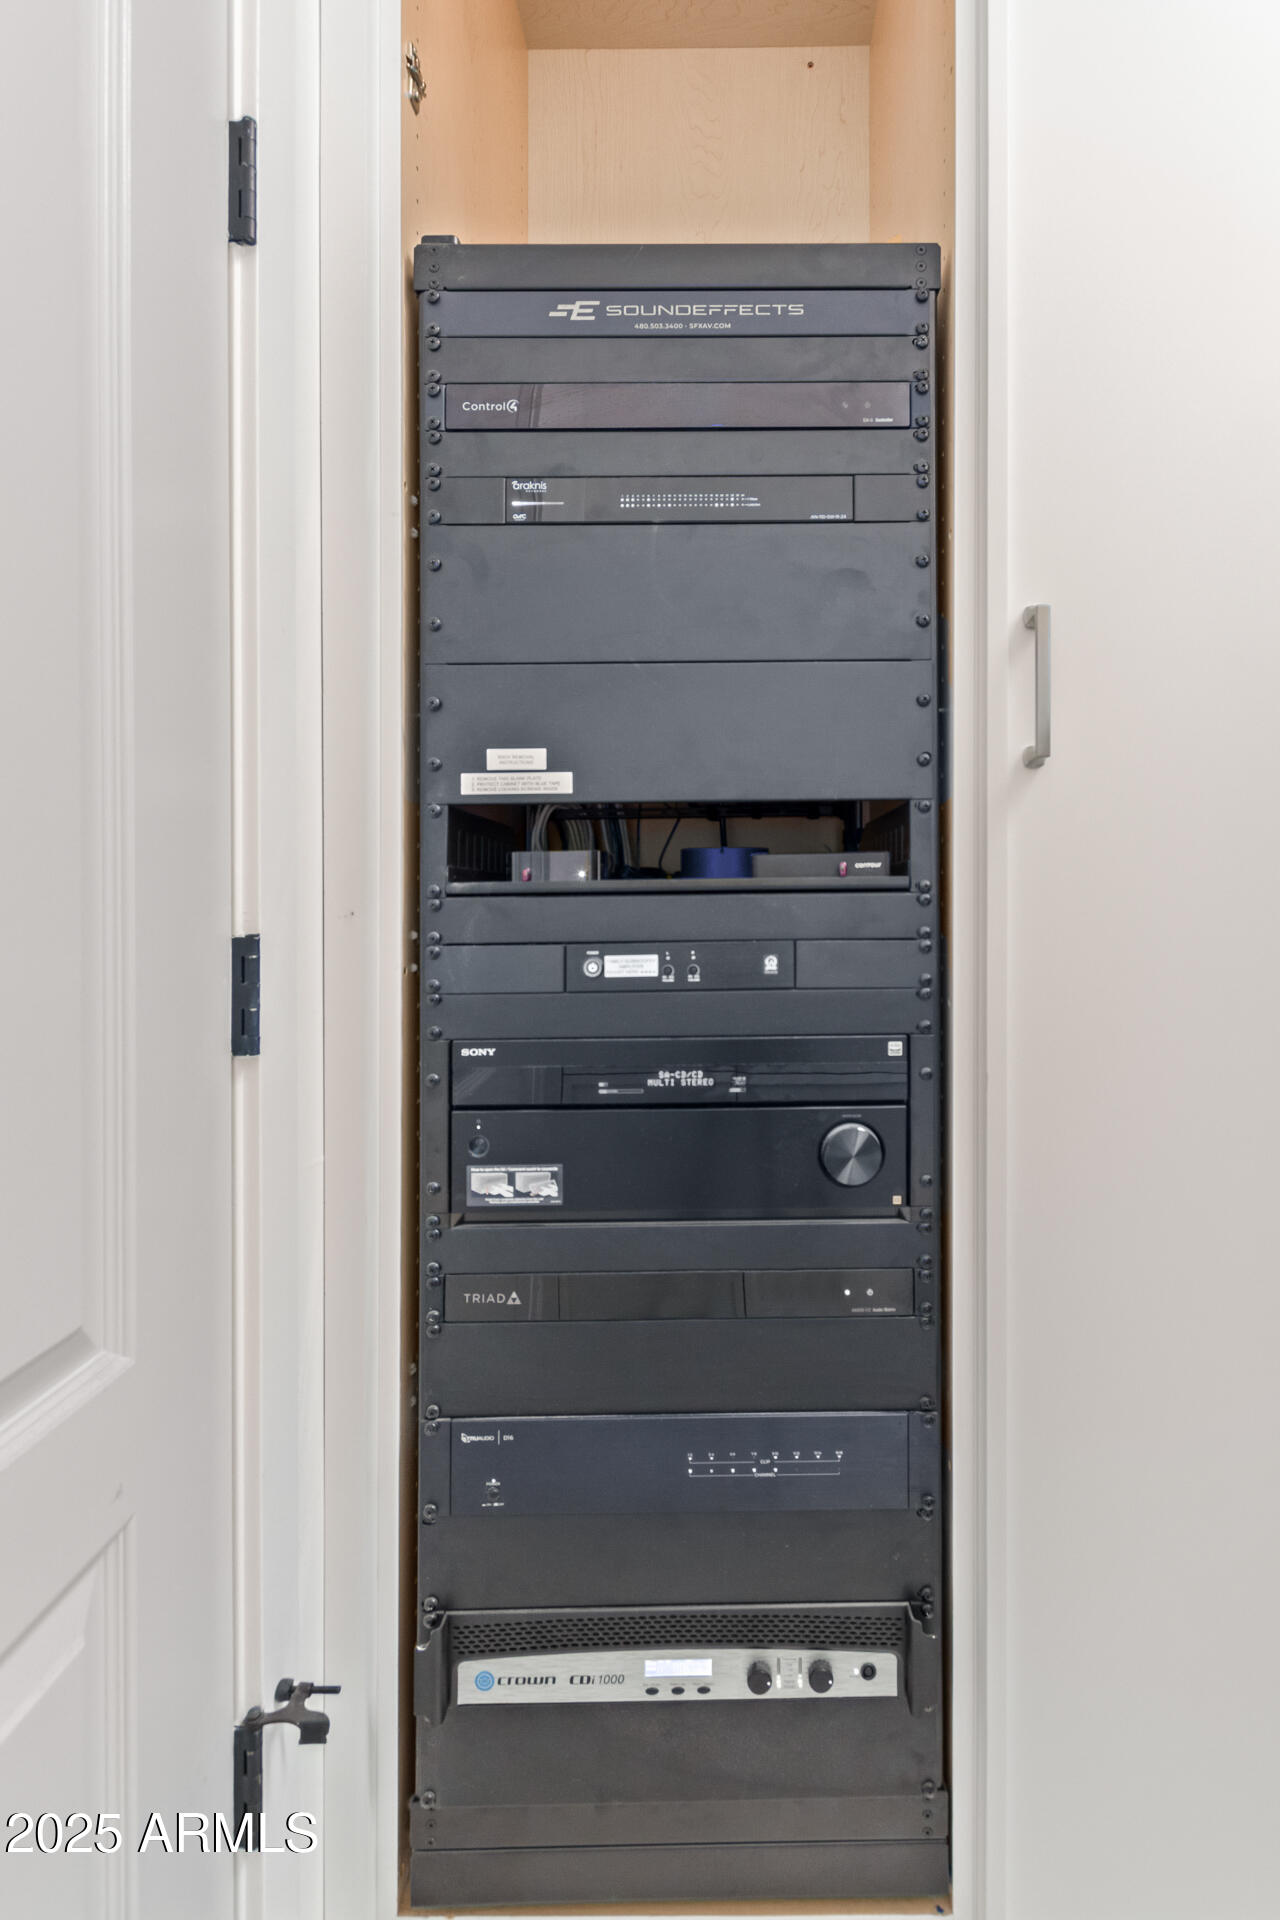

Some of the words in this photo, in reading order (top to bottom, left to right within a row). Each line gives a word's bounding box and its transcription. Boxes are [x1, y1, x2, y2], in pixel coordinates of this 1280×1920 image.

[606, 304, 804, 316] SOUNDEFFECTS
[461, 1048, 496, 1057] SONY
[680, 1078, 714, 1086] STEREO
[464, 1293, 505, 1304] TRIAD
